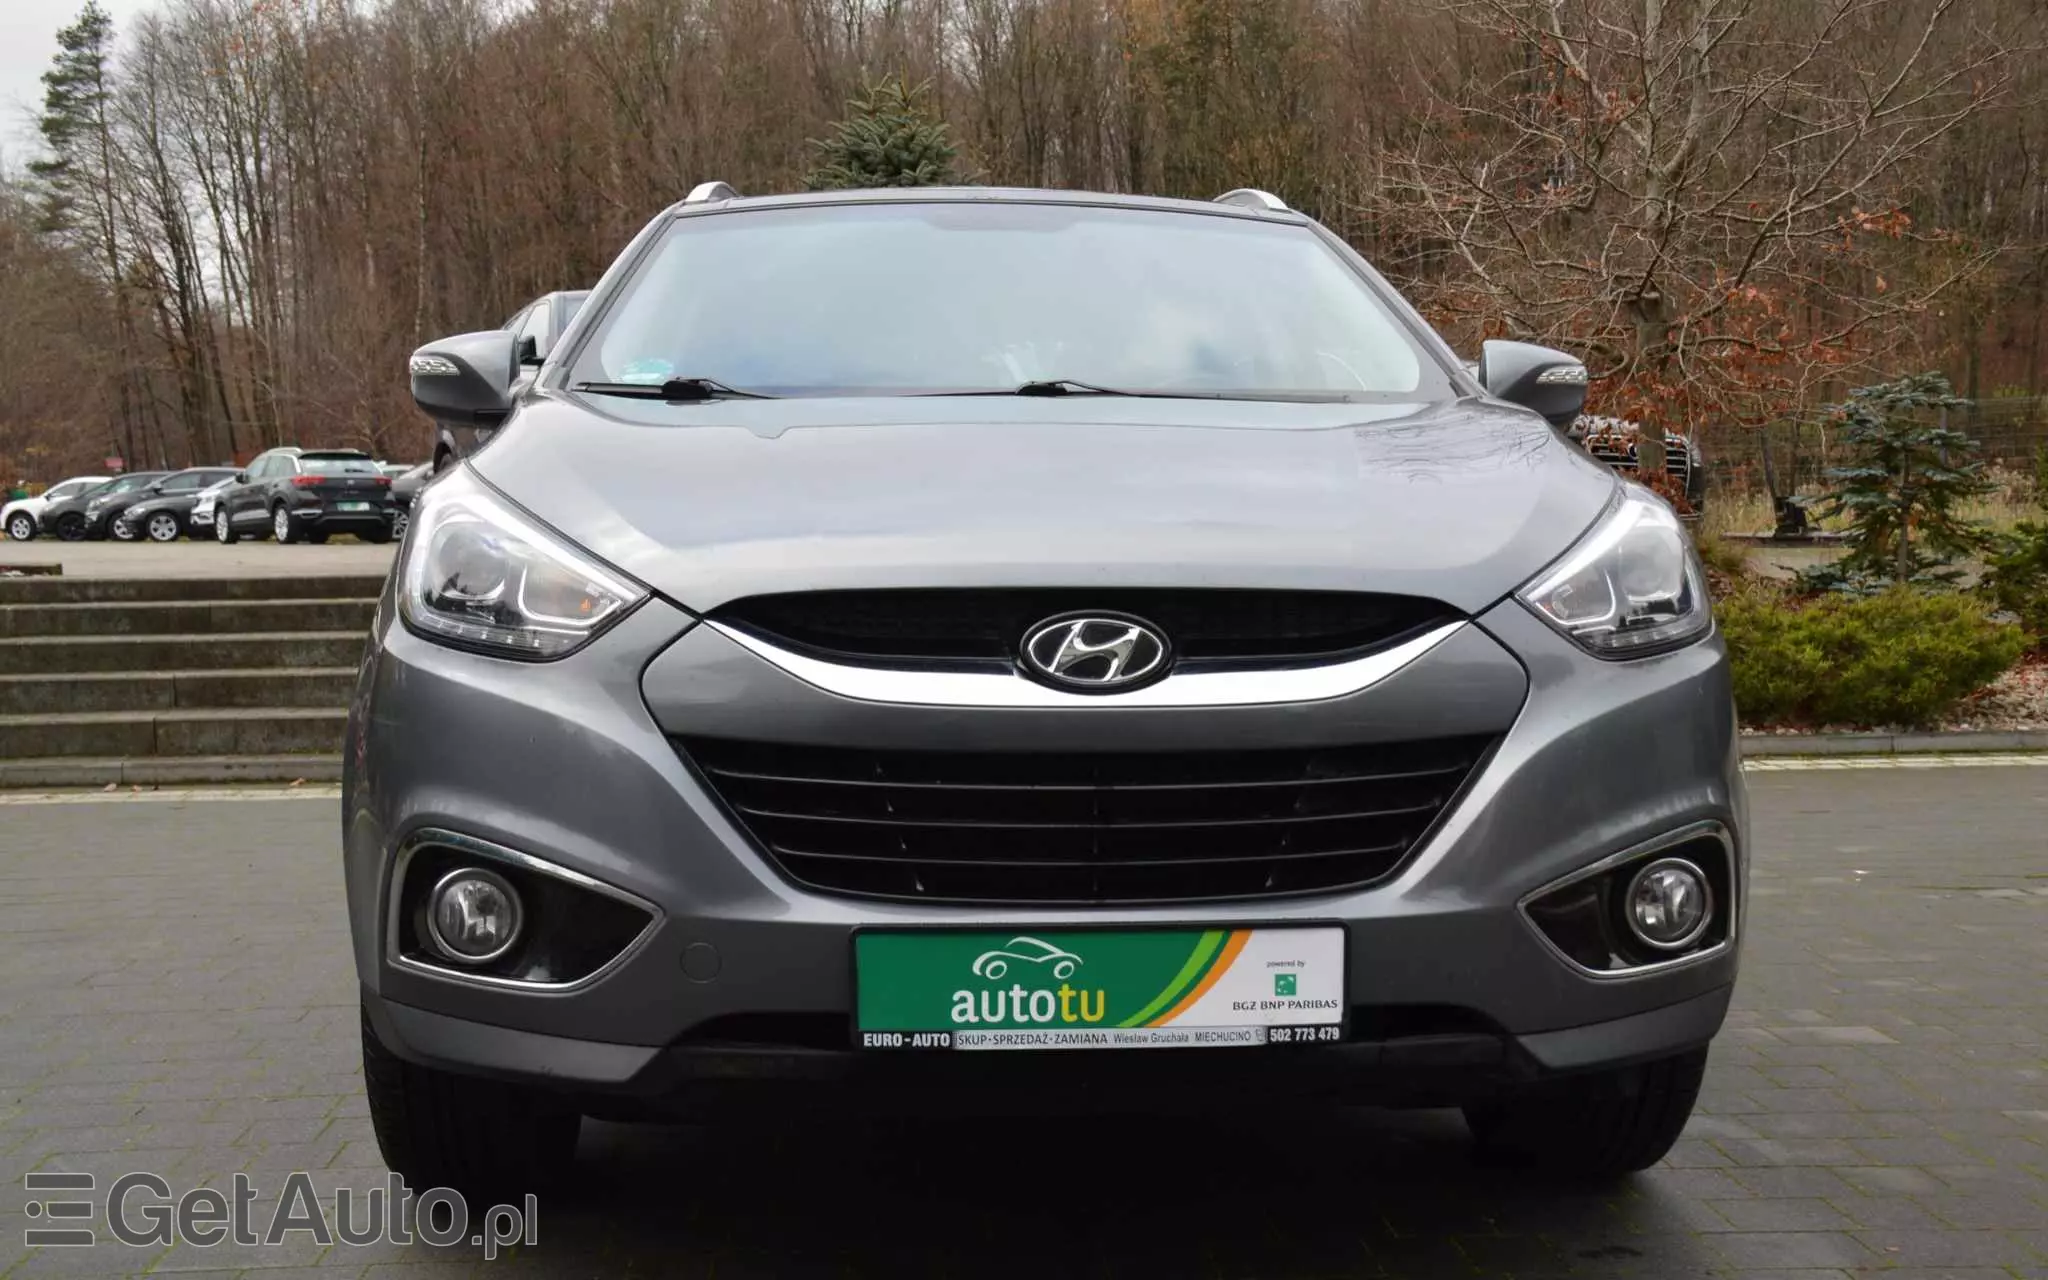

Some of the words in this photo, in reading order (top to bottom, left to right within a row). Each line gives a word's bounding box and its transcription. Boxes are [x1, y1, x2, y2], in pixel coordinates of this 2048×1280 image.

[1266, 960, 1296, 968] powered
[1297, 960, 1305, 968] by
[951, 984, 1105, 1023] autotu
[1260, 1000, 1285, 1010] BNP
[1287, 999, 1338, 1009] PARIBAS
[1194, 1030, 1251, 1043] MIECHUCINO
[1270, 1028, 1292, 1042] 502
[1294, 1028, 1316, 1041] 773
[1318, 1027, 1340, 1040] 479
